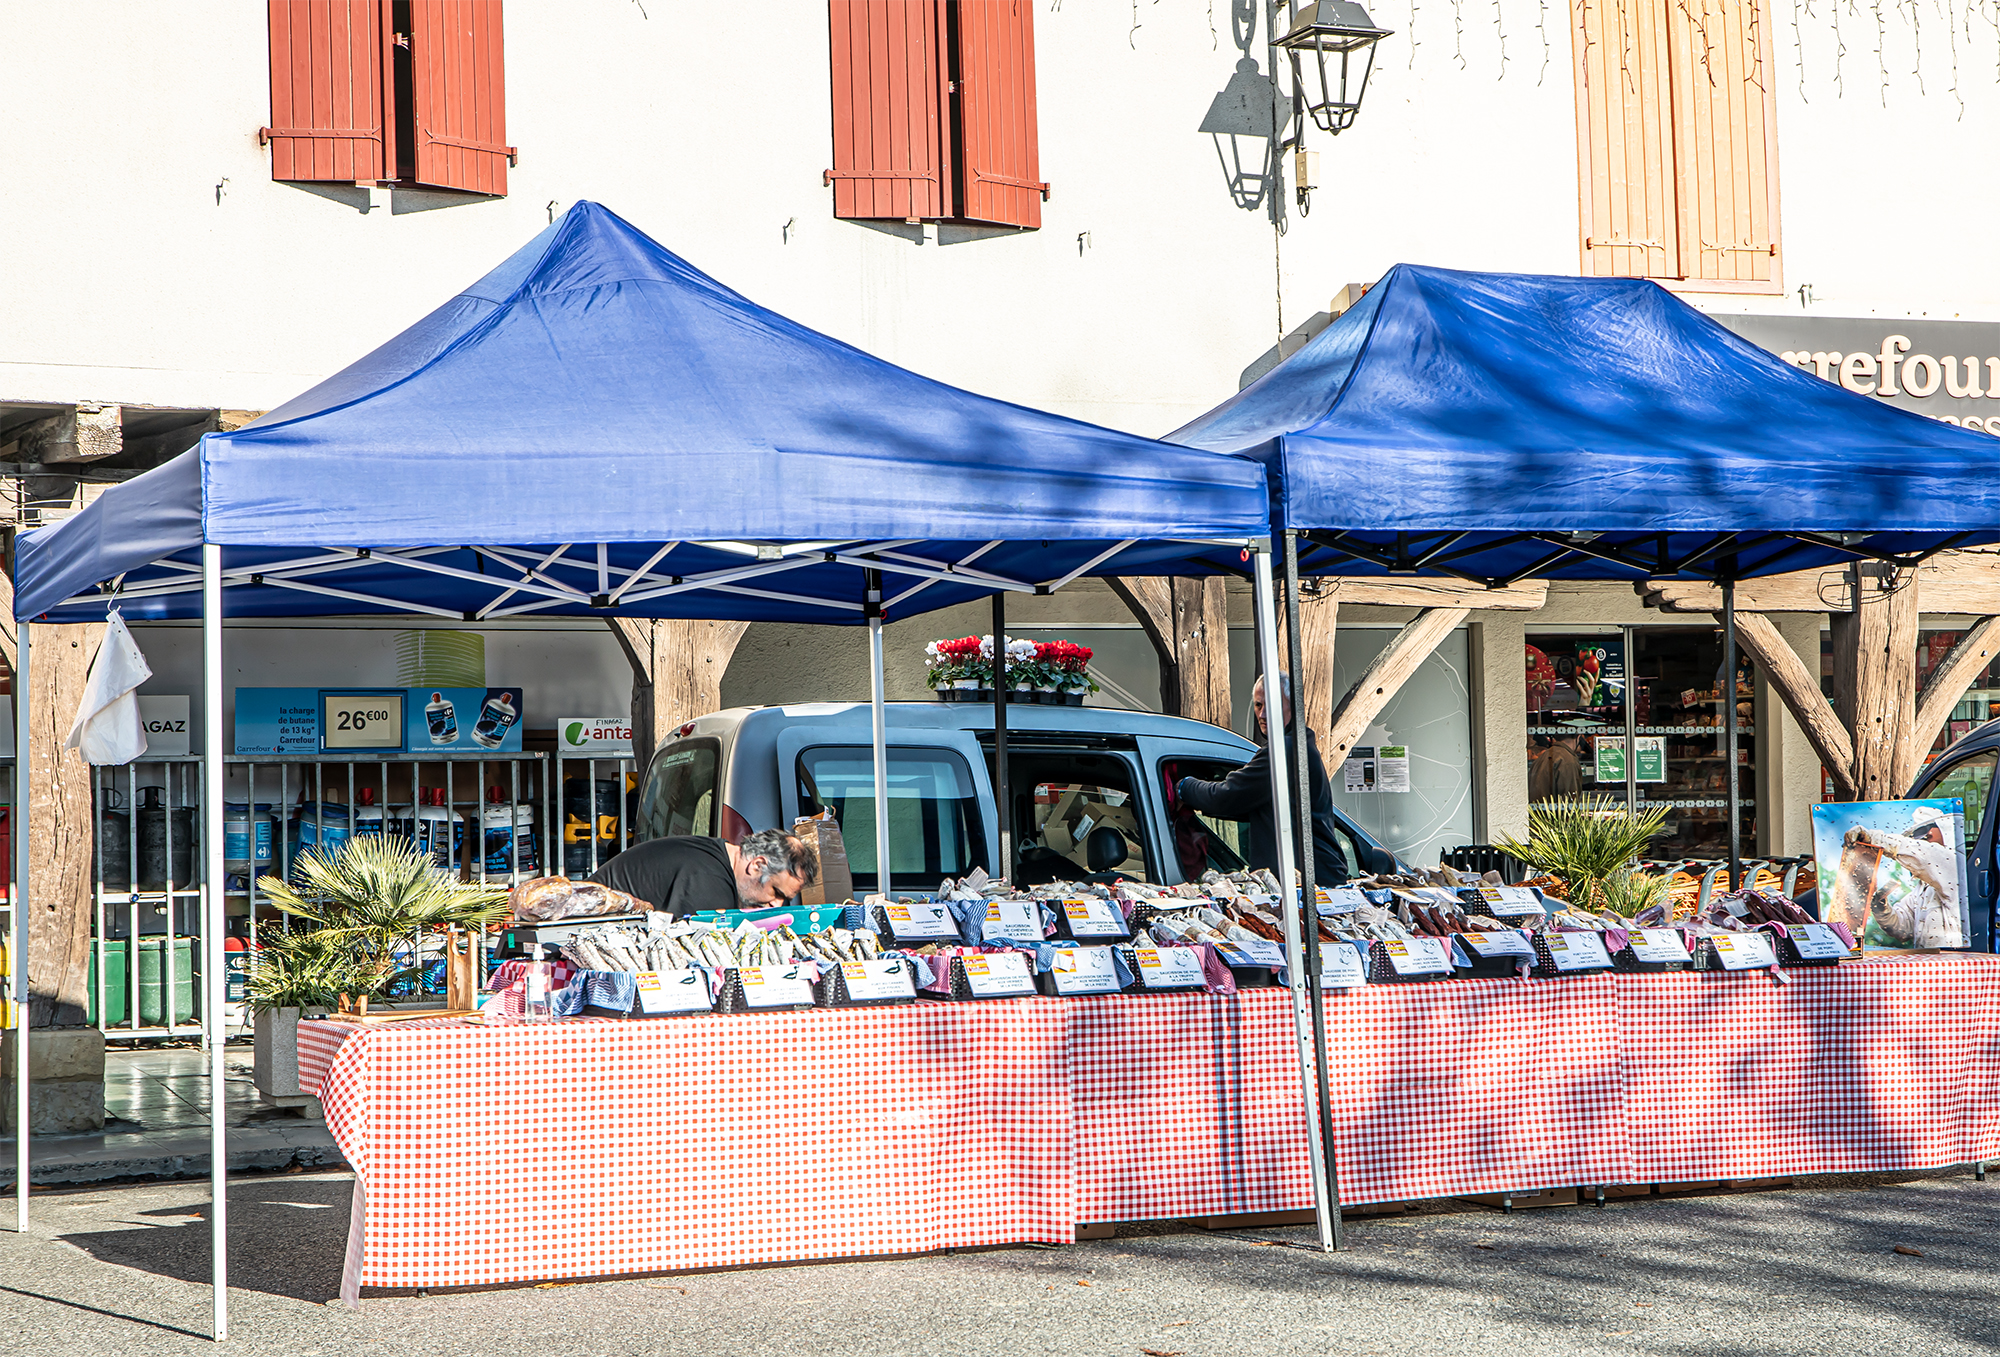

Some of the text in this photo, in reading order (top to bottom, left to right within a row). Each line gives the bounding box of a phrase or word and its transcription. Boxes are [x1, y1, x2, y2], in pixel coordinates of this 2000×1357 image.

[289, 707, 315, 716] charge
[280, 726, 290, 734] de
[279, 736, 316, 744] Carrefour
